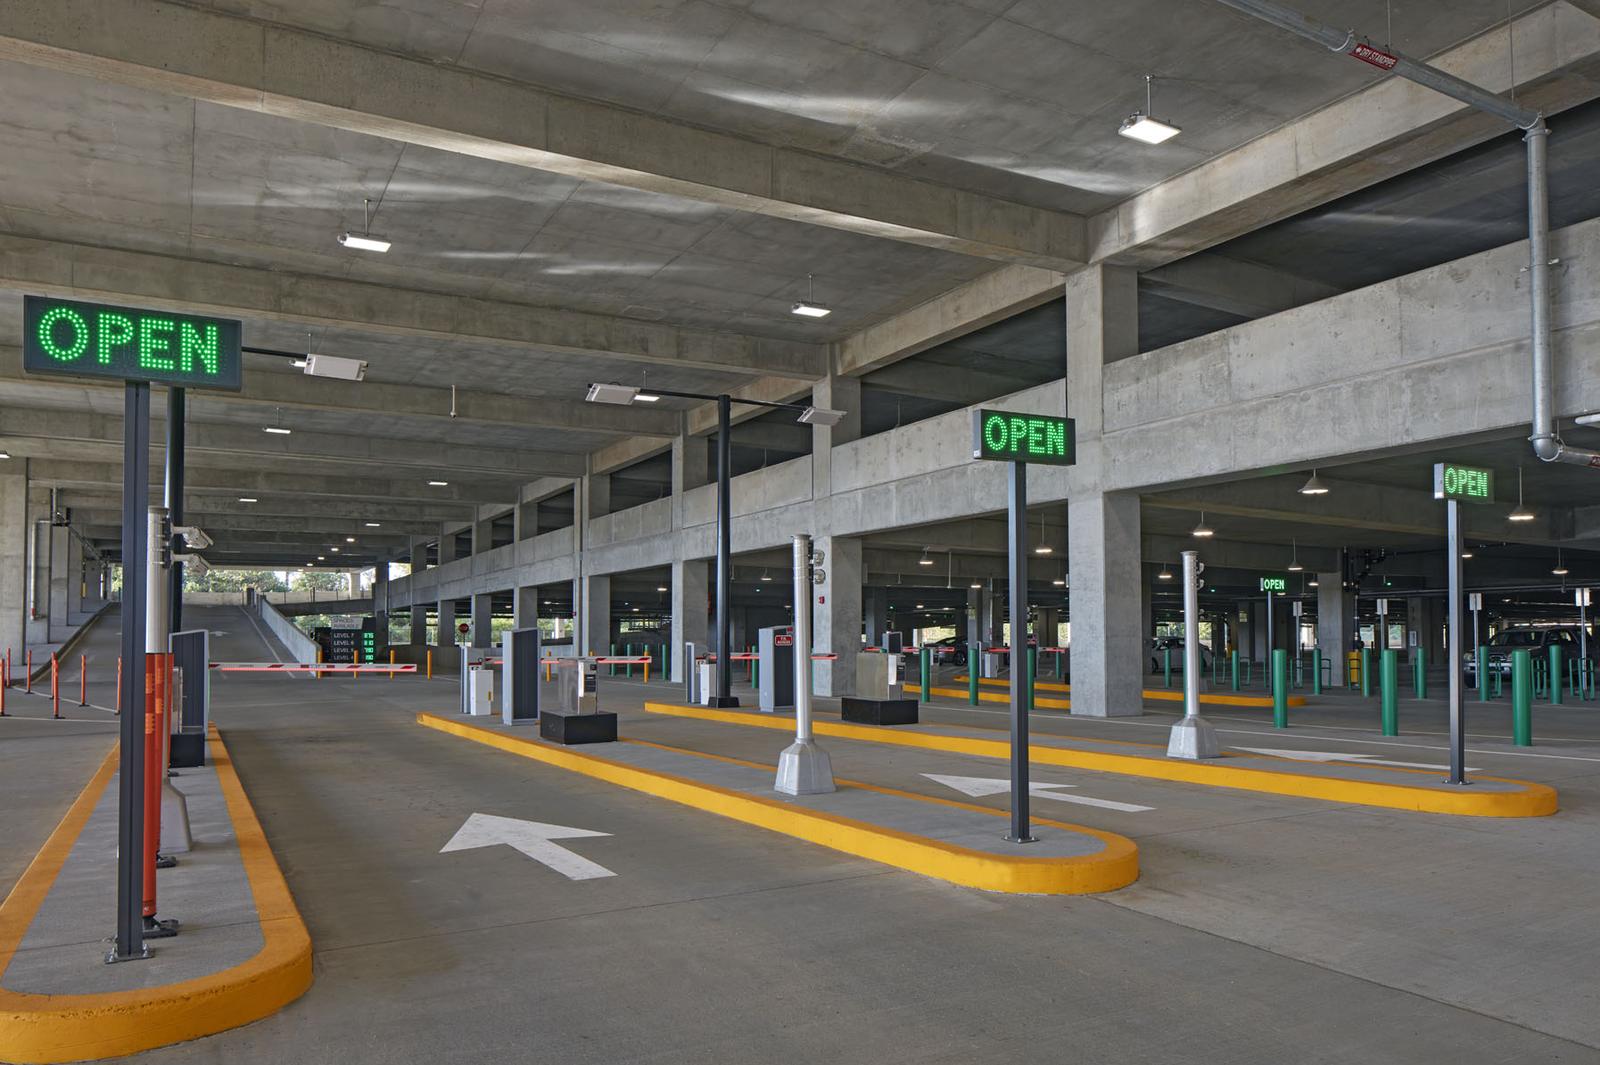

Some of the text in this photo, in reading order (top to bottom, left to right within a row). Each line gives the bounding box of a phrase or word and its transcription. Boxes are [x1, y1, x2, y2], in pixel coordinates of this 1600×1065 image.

[1359, 47, 1396, 67] DRY STANDPIPE
[39, 307, 219, 374] OPEN
[985, 415, 1065, 456] OPEN
[1444, 467, 1488, 497] OPEN
[1264, 579, 1284, 589] OPEN
